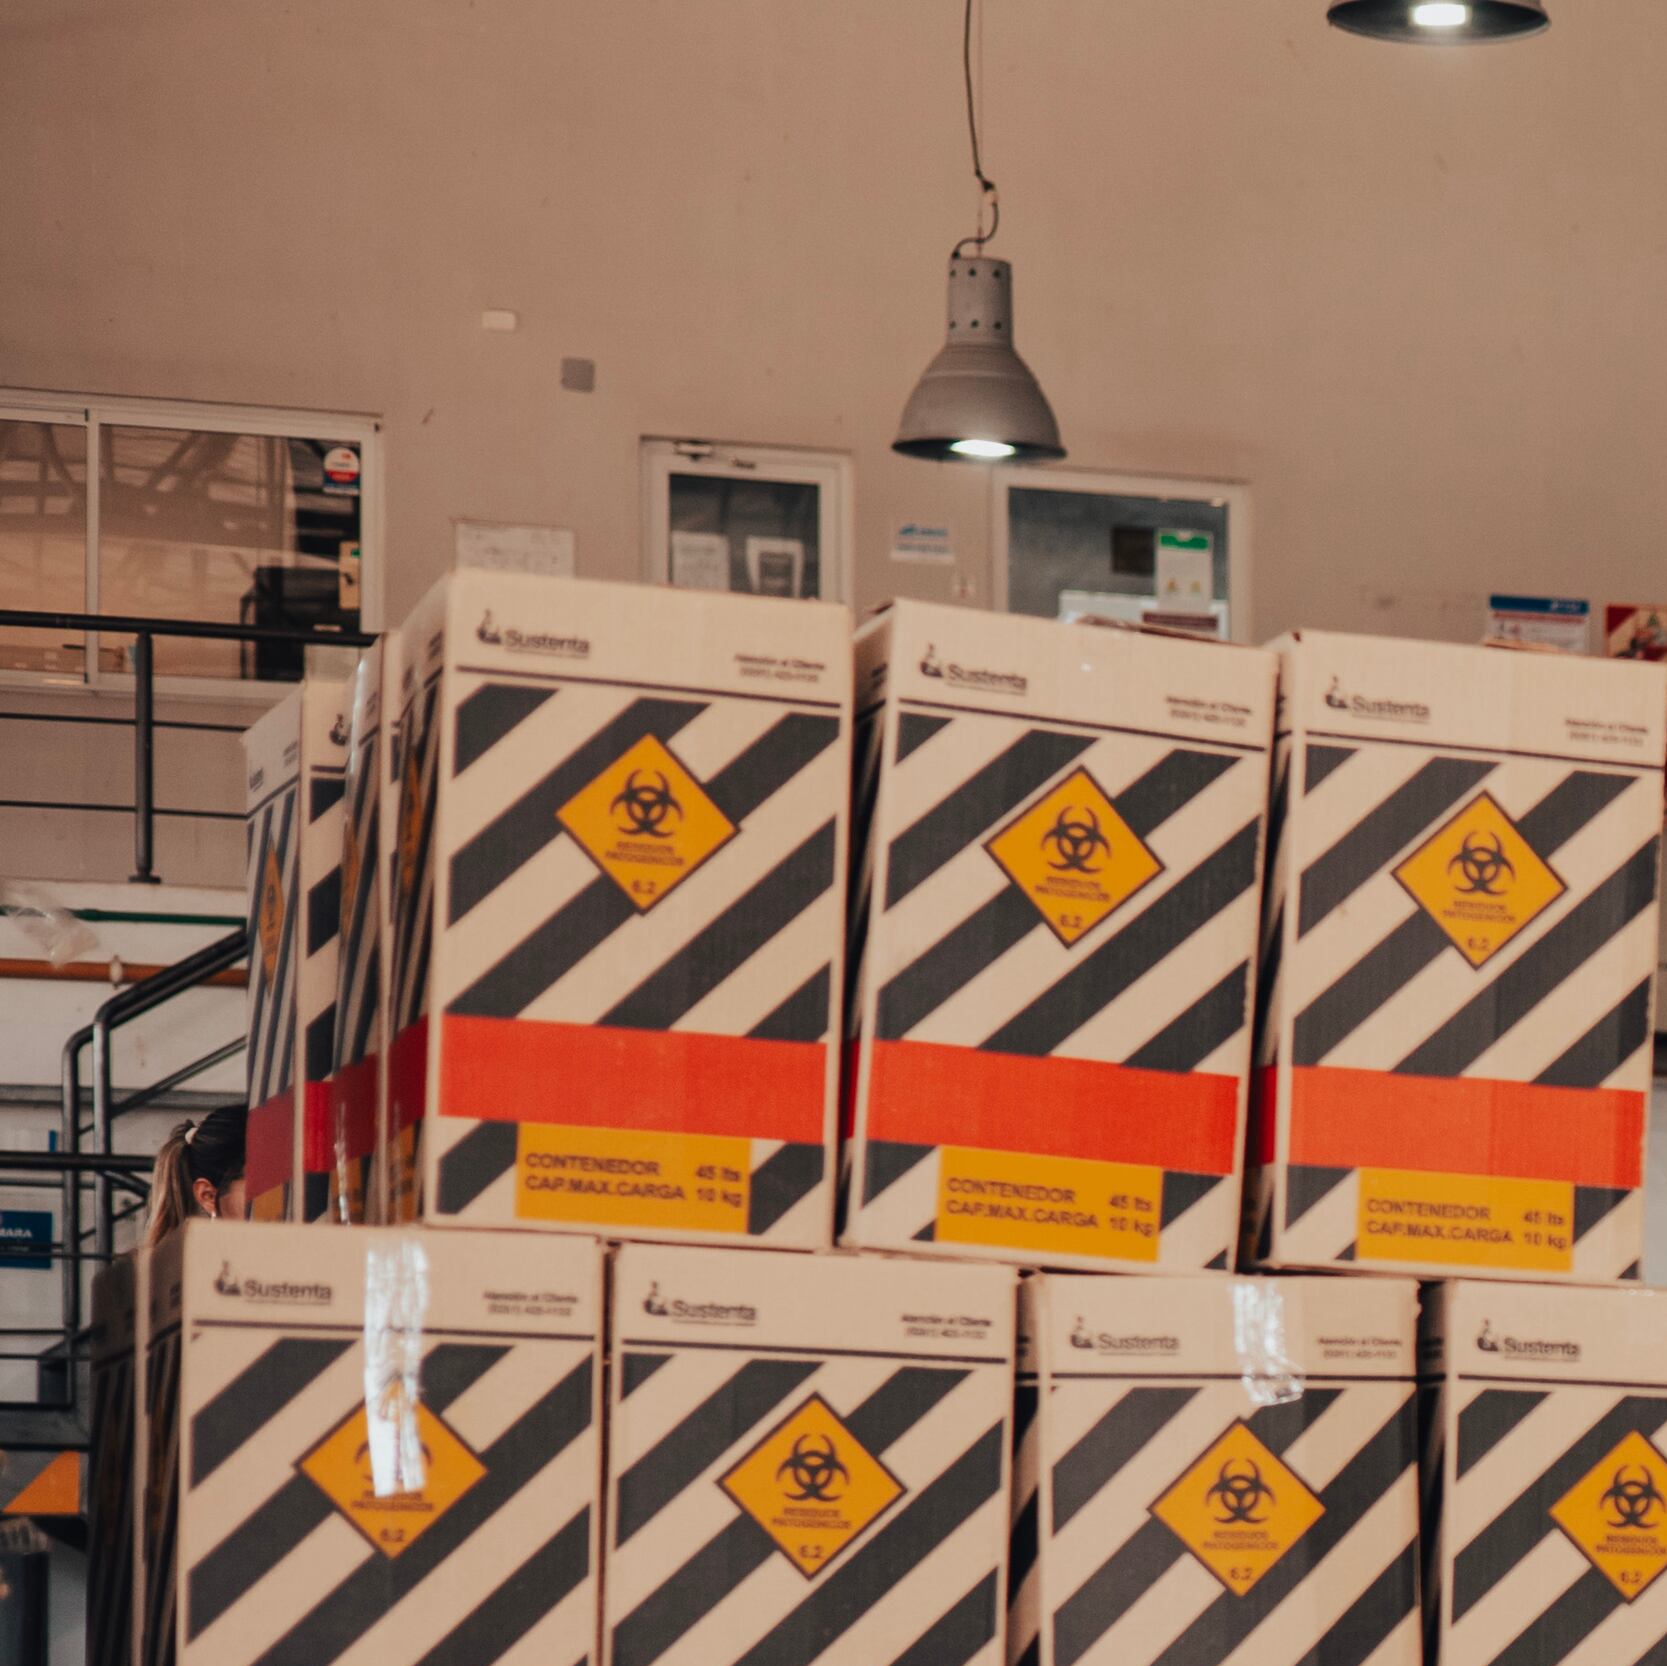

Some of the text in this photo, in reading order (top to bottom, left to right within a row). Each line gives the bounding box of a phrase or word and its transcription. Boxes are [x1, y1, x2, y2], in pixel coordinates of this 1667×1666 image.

[505, 628, 591, 653] Sustenta
[946, 662, 1029, 689] Sustenta
[1351, 694, 1432, 718] Sustenta
[631, 878, 656, 895] 6.2
[1059, 912, 1084, 928] 6.2
[1466, 935, 1491, 950] 6.2
[524, 1151, 741, 1182] CONTENEDOR 45 lts
[695, 1186, 716, 1202] 10
[721, 1188, 744, 1208] kg
[946, 1175, 1154, 1212] CONTENEDOR 45 lts
[1365, 1197, 1566, 1227] CONTENEDOR 45 lts
[1108, 1215, 1128, 1231] 10
[1132, 1218, 1154, 1237] kg
[1523, 1230, 1542, 1245] 10
[1547, 1232, 1567, 1250] kg
[244, 1278, 333, 1299] Sustenta
[672, 1298, 758, 1319] Sustenta
[1097, 1331, 1181, 1350] Sustenta
[1502, 1336, 1582, 1355] Sustenta
[380, 1527, 408, 1543] 6.2
[797, 1543, 824, 1557] 6.2
[1229, 1566, 1255, 1580] 6.2
[1618, 1570, 1642, 1584] 6.2
